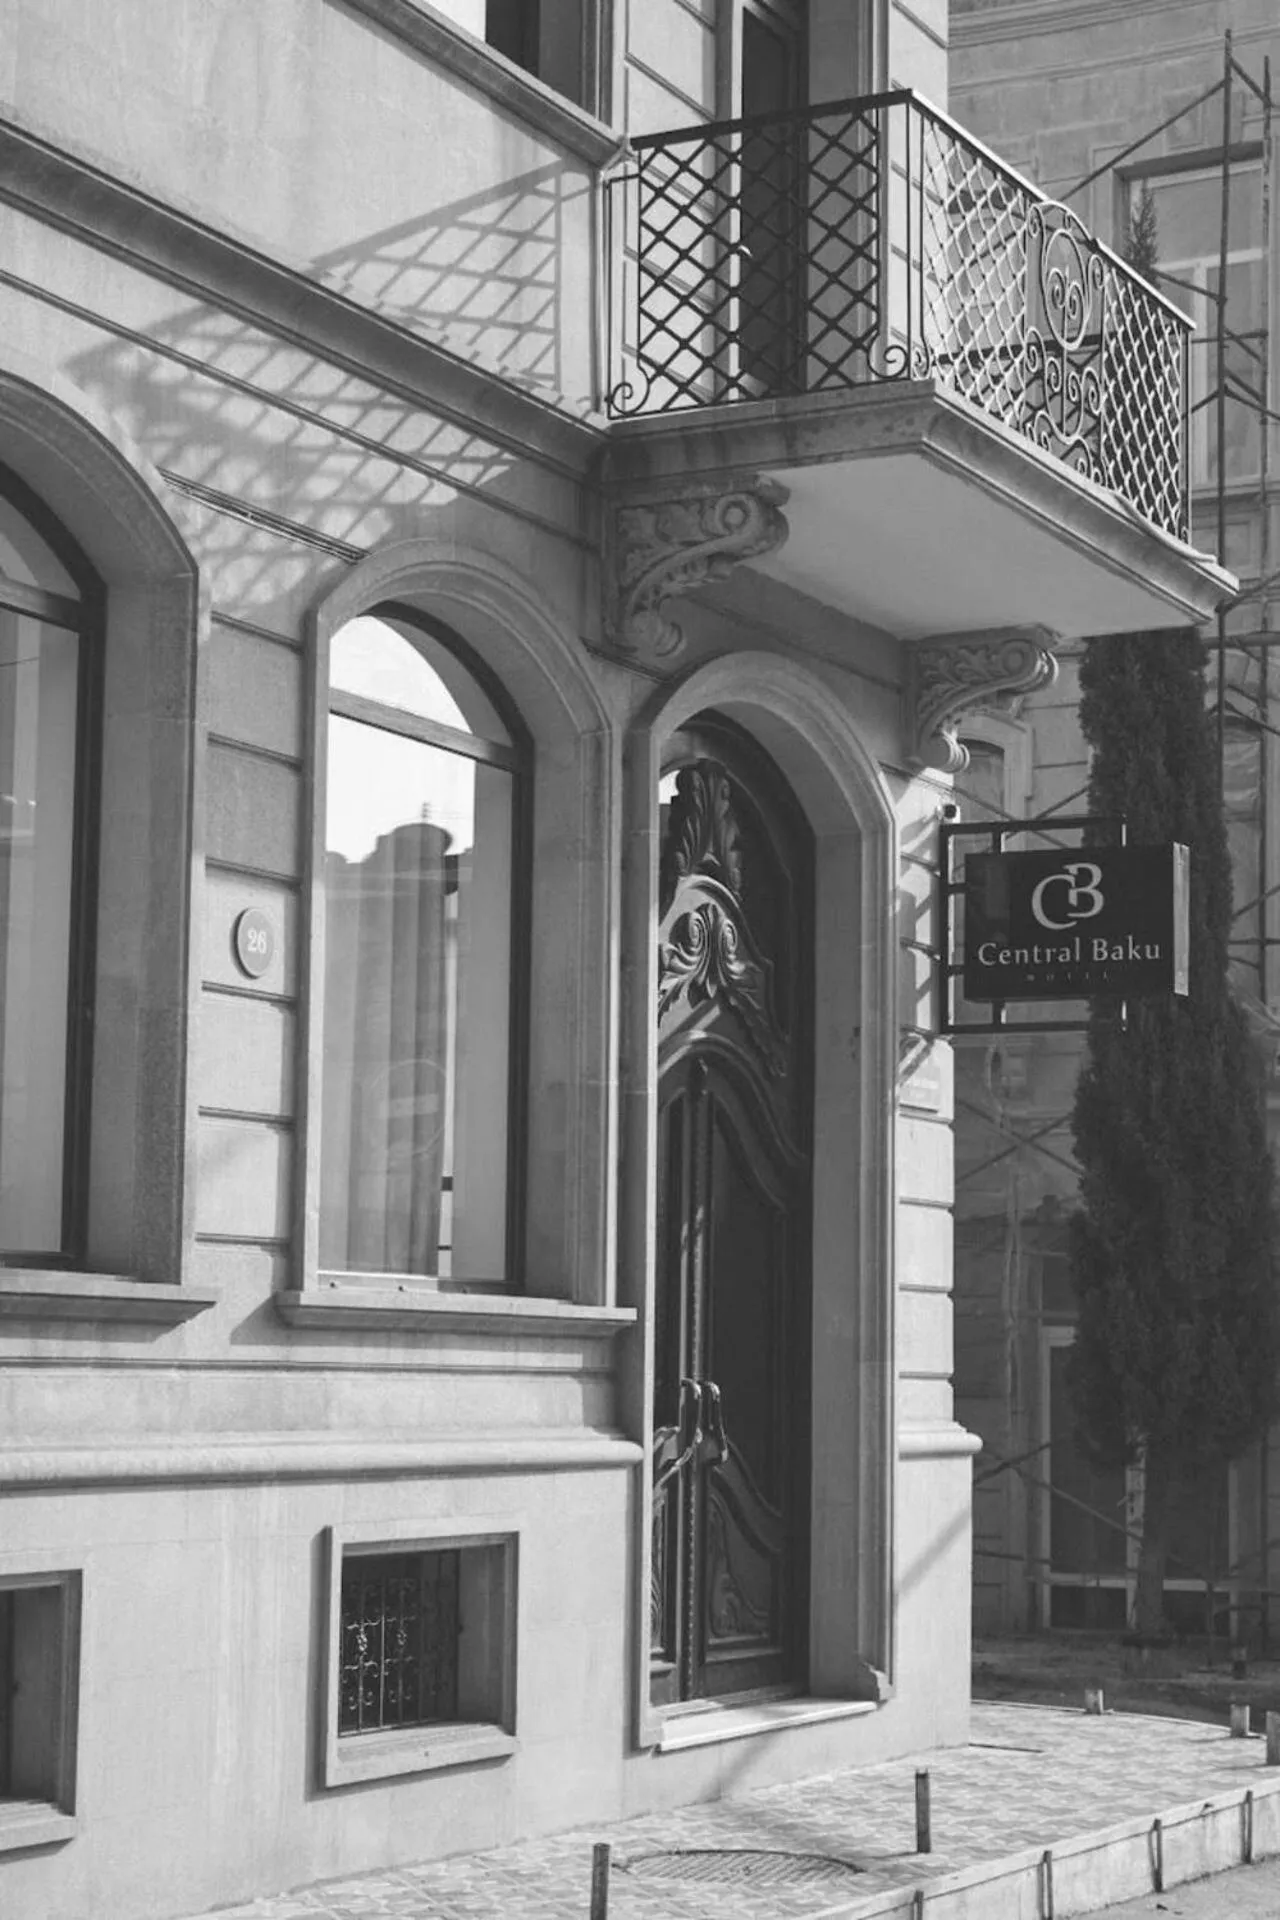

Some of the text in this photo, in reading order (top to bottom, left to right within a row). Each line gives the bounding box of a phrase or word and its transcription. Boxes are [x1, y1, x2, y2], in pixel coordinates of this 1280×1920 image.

[246, 926, 268, 954] 26
[977, 934, 1161, 966] Central Baku
